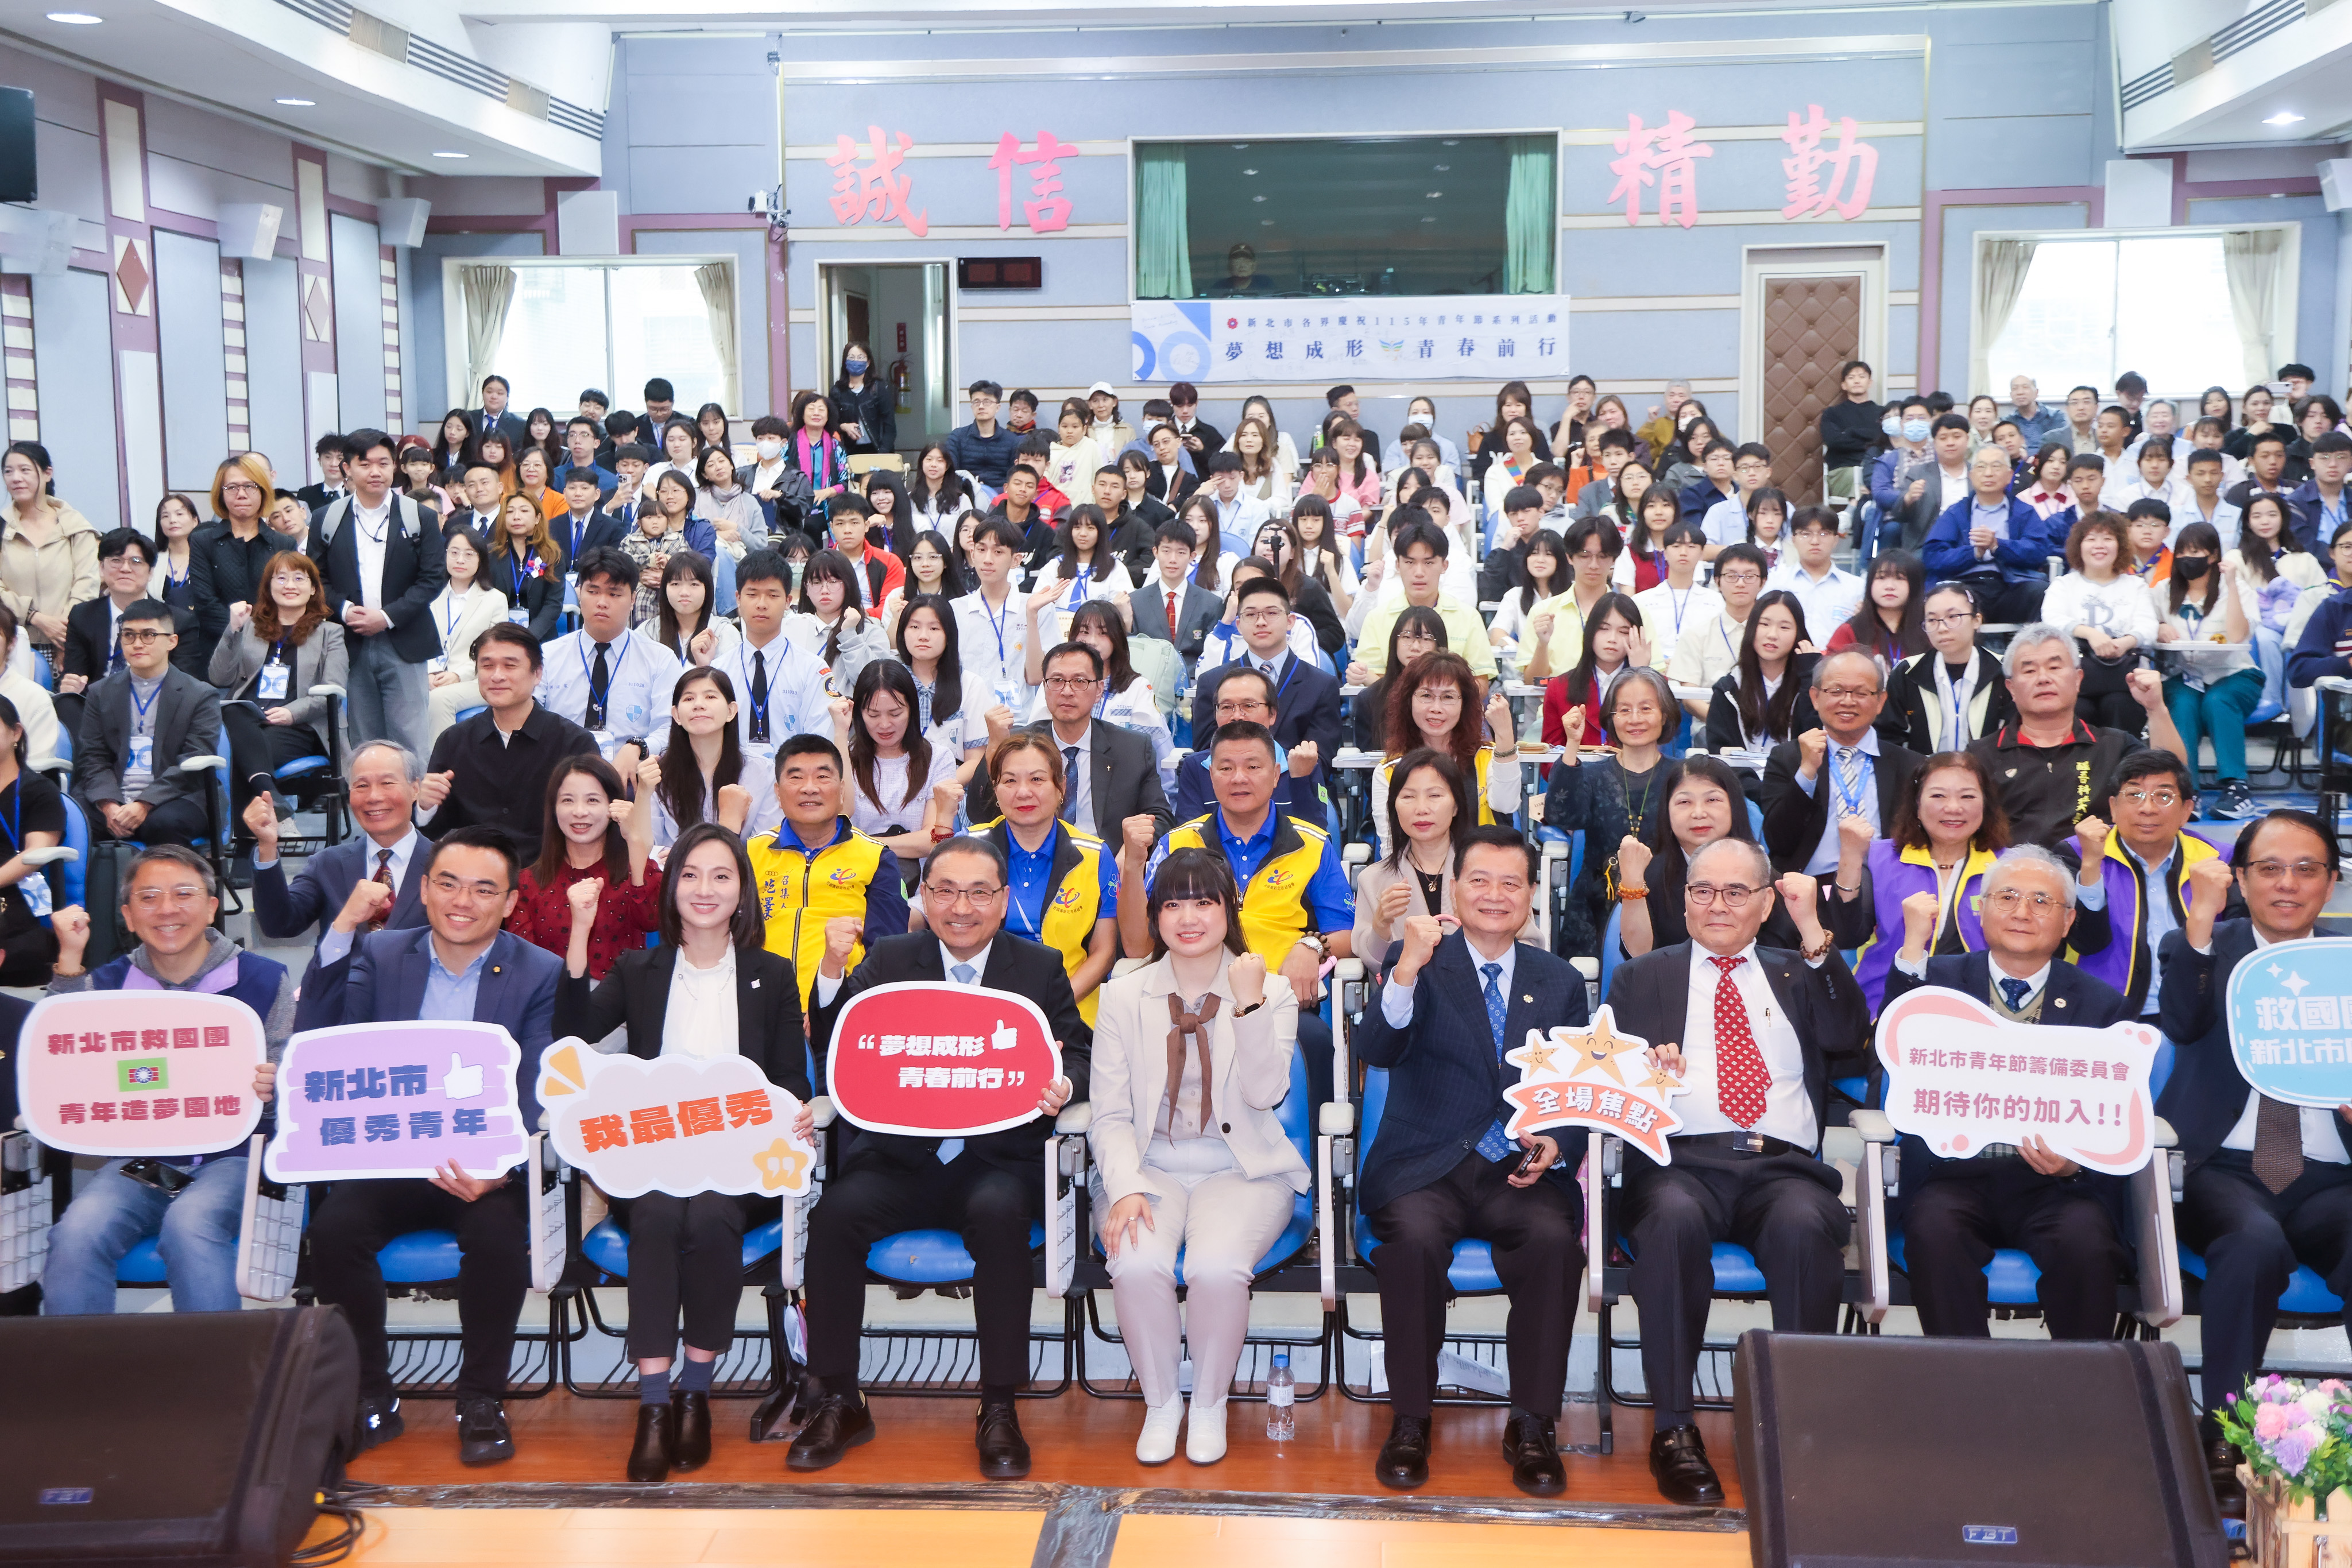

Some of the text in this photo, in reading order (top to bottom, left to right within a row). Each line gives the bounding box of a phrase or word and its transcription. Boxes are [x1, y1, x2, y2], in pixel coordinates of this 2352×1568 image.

[825, 125, 1079, 237] 誠信
[1607, 104, 1878, 229] 精勤
[1247, 313, 1557, 328] 新北市各界慶祝115年青年節系列活動
[1225, 339, 1364, 361] 夢想成形
[1417, 337, 1556, 358] 青春前行
[2255, 996, 2352, 1031] 救國
[48, 1026, 230, 1055] 新北市救國團
[2249, 1037, 2352, 1065] 新北市
[1909, 1048, 2130, 1081] 新北市青年節籌備委員會
[304, 1064, 428, 1103] 新北市
[59, 1095, 241, 1125] 青年造夢園地
[320, 1108, 488, 1146] 優秀青年
[579, 1089, 773, 1153] 我最優秀
[1531, 1086, 1658, 1134] 全場焦點
[1968, 1528, 2011, 1541] FBT
